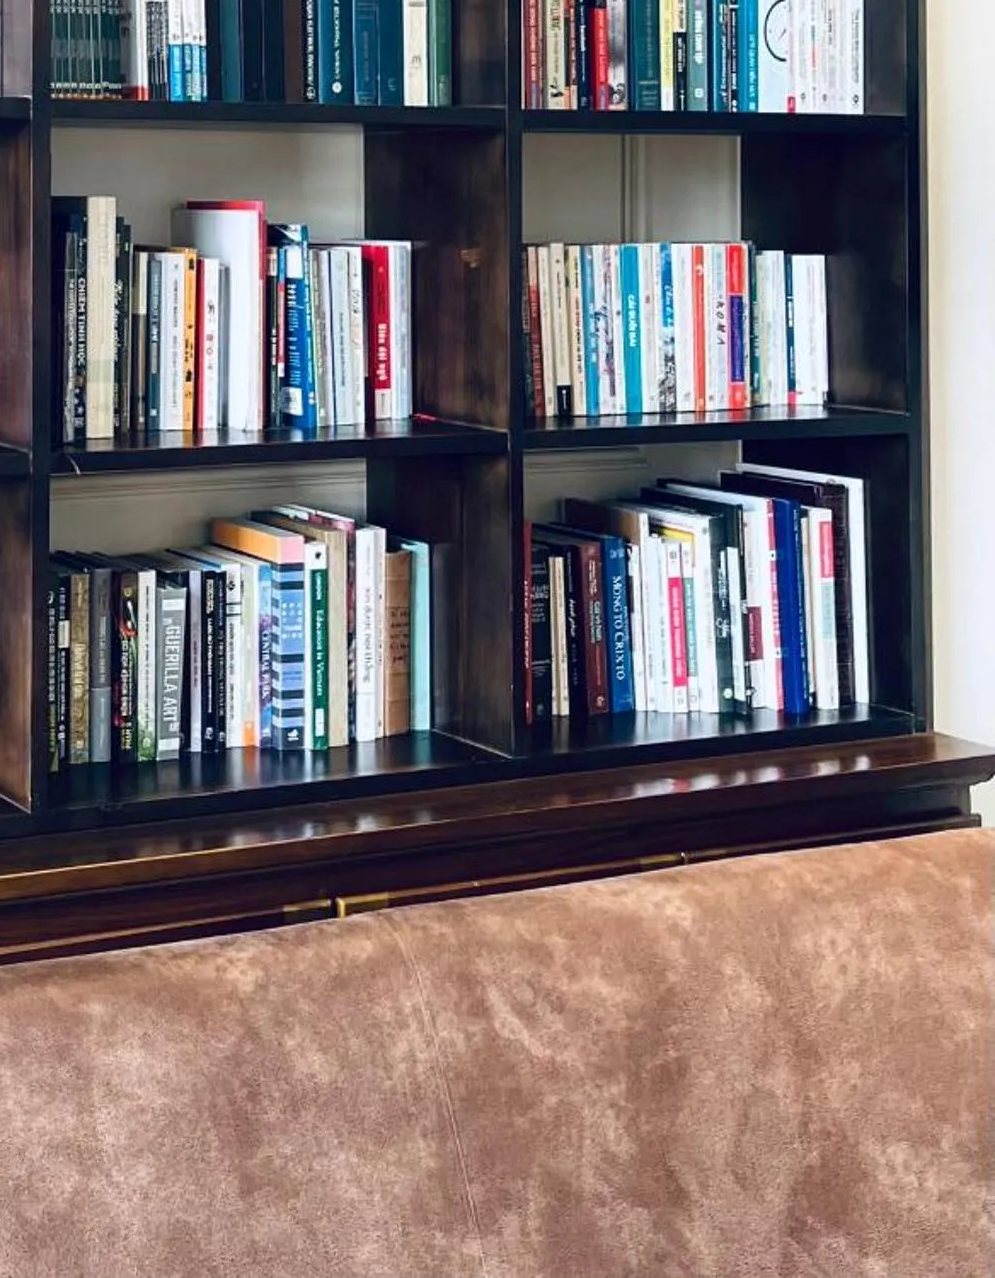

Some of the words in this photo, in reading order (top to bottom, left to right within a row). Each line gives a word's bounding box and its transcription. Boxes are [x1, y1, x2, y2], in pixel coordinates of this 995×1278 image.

[163, 625, 182, 692] GUERILLA
[261, 631, 271, 671] CENTRAL
[261, 673, 271, 699] PARK
[163, 696, 178, 722] ART
